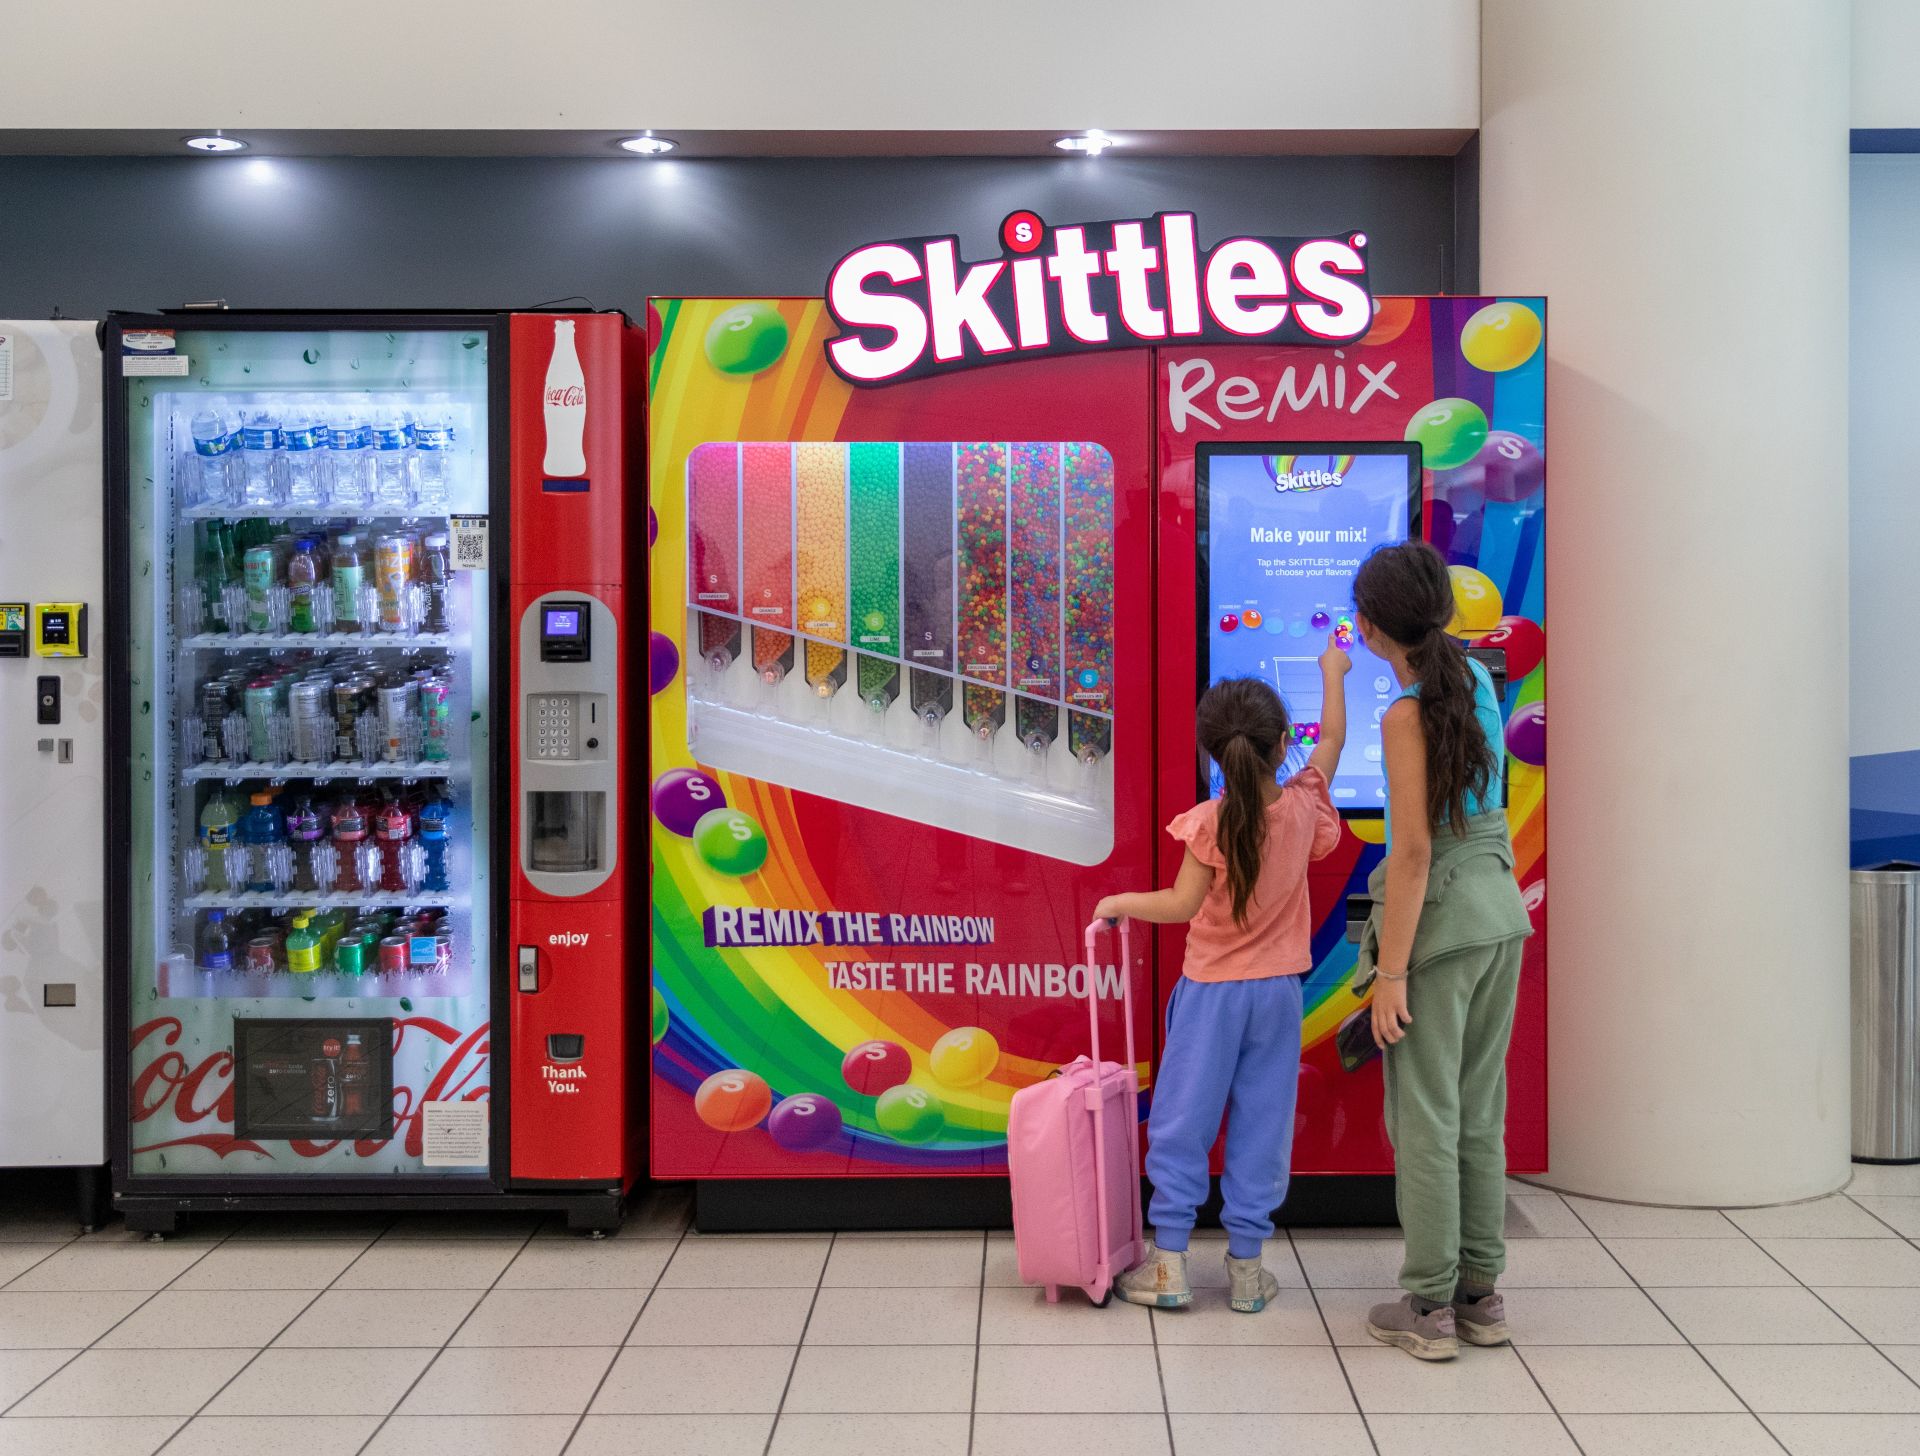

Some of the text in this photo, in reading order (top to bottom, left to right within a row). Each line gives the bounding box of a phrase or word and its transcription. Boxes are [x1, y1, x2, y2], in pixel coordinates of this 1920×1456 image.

[1015, 221, 1033, 242] S
[829, 211, 1372, 381] Skittles
[1497, 436, 1524, 460] S
[1275, 469, 1342, 492] Skittles
[1250, 527, 1367, 546] Make your mix!
[1257, 558, 1272, 568] Tap
[1336, 558, 1361, 568] candy
[710, 574, 718, 583] S
[1461, 575, 1486, 600] S
[764, 589, 772, 598] S
[925, 632, 932, 640] S
[978, 646, 986, 654] S
[1032, 660, 1039, 668] S
[1260, 661, 1265, 669] 5
[1085, 674, 1092, 683] S
[686, 777, 711, 801] S
[728, 818, 752, 841] S
[713, 905, 995, 945] REMIX THE RAINBOW
[549, 931, 589, 947] enjoy
[825, 960, 1125, 1000] TASTE THE RAINBOW
[865, 1042, 887, 1060] S
[541, 1065, 587, 1079] Thank
[548, 1080, 580, 1093] You.
[721, 1074, 745, 1092] S
[793, 1097, 816, 1116] S
[906, 1087, 929, 1108] S
